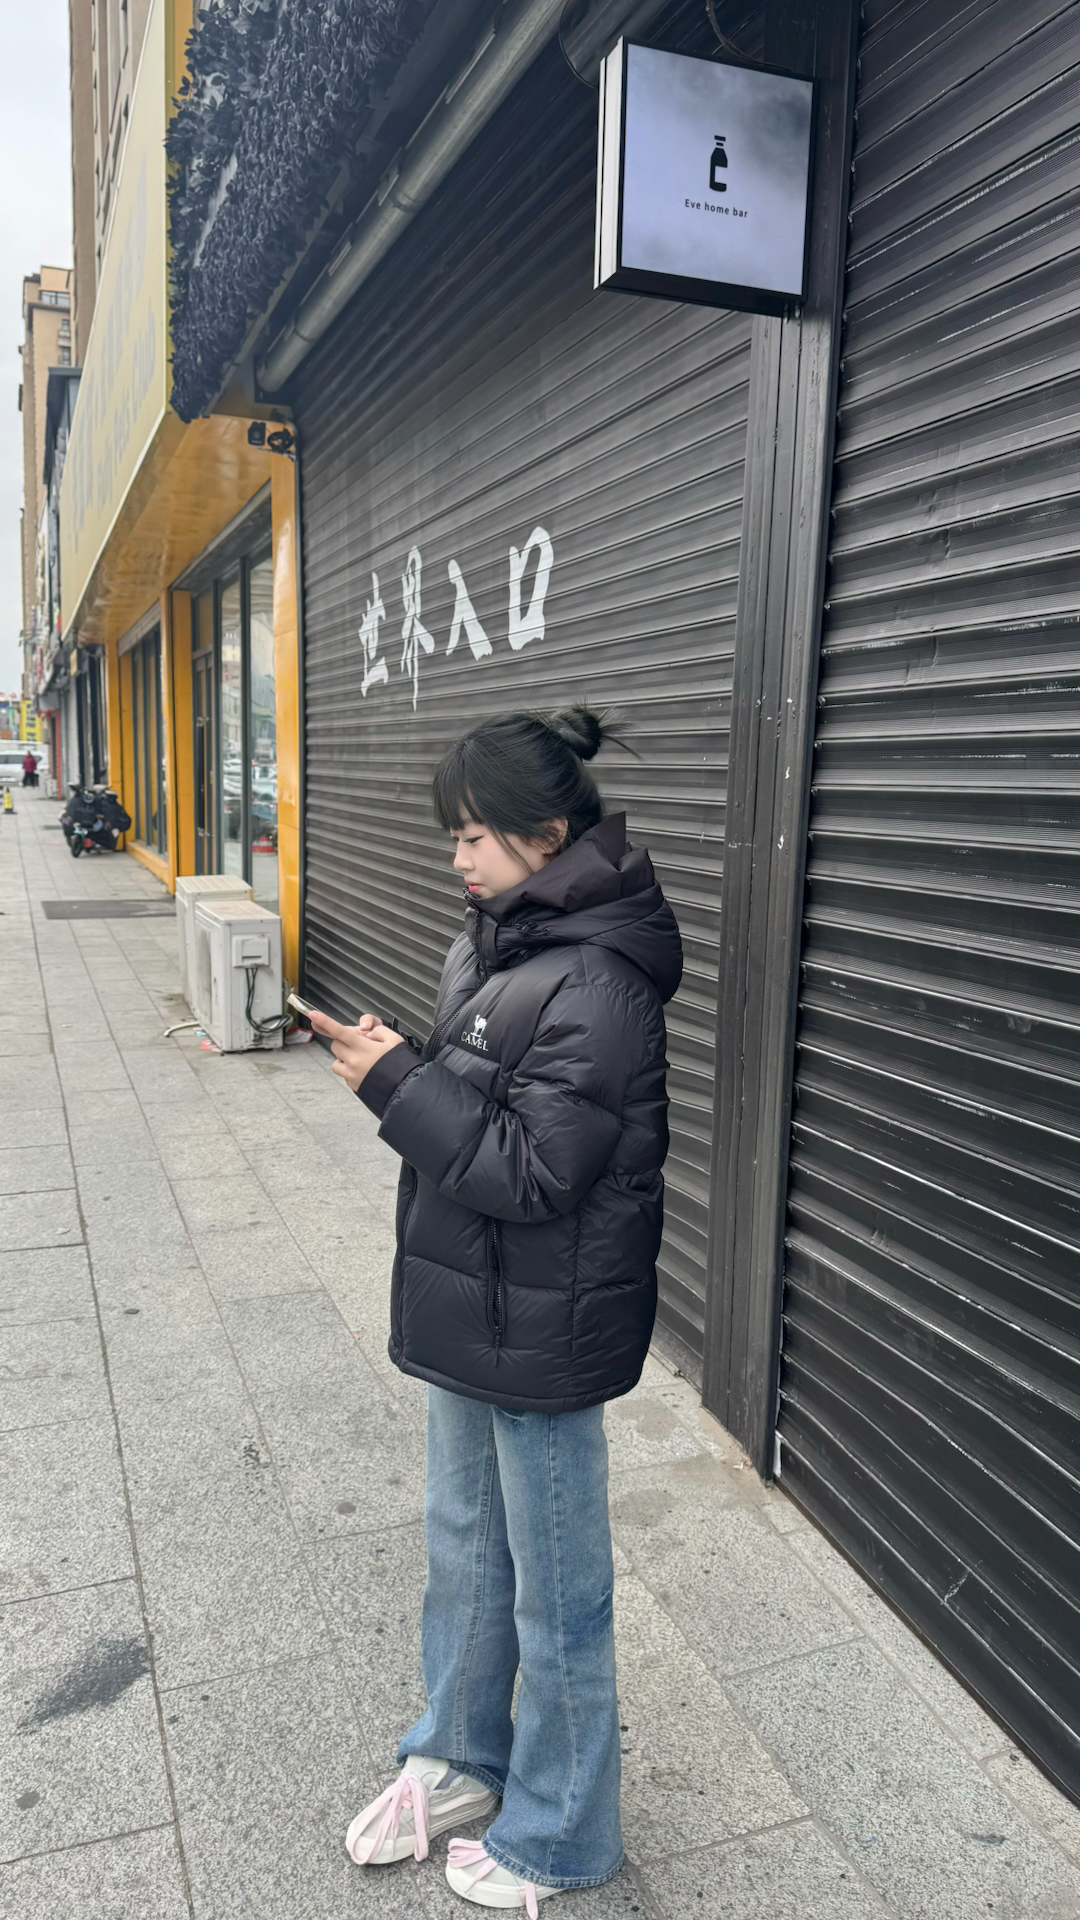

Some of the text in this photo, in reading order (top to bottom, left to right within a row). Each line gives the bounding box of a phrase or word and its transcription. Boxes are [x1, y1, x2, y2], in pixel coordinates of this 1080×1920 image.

[685, 198, 748, 218] Eve home bar
[359, 526, 554, 711] 世界入口
[461, 1031, 488, 1051] CAMEL
